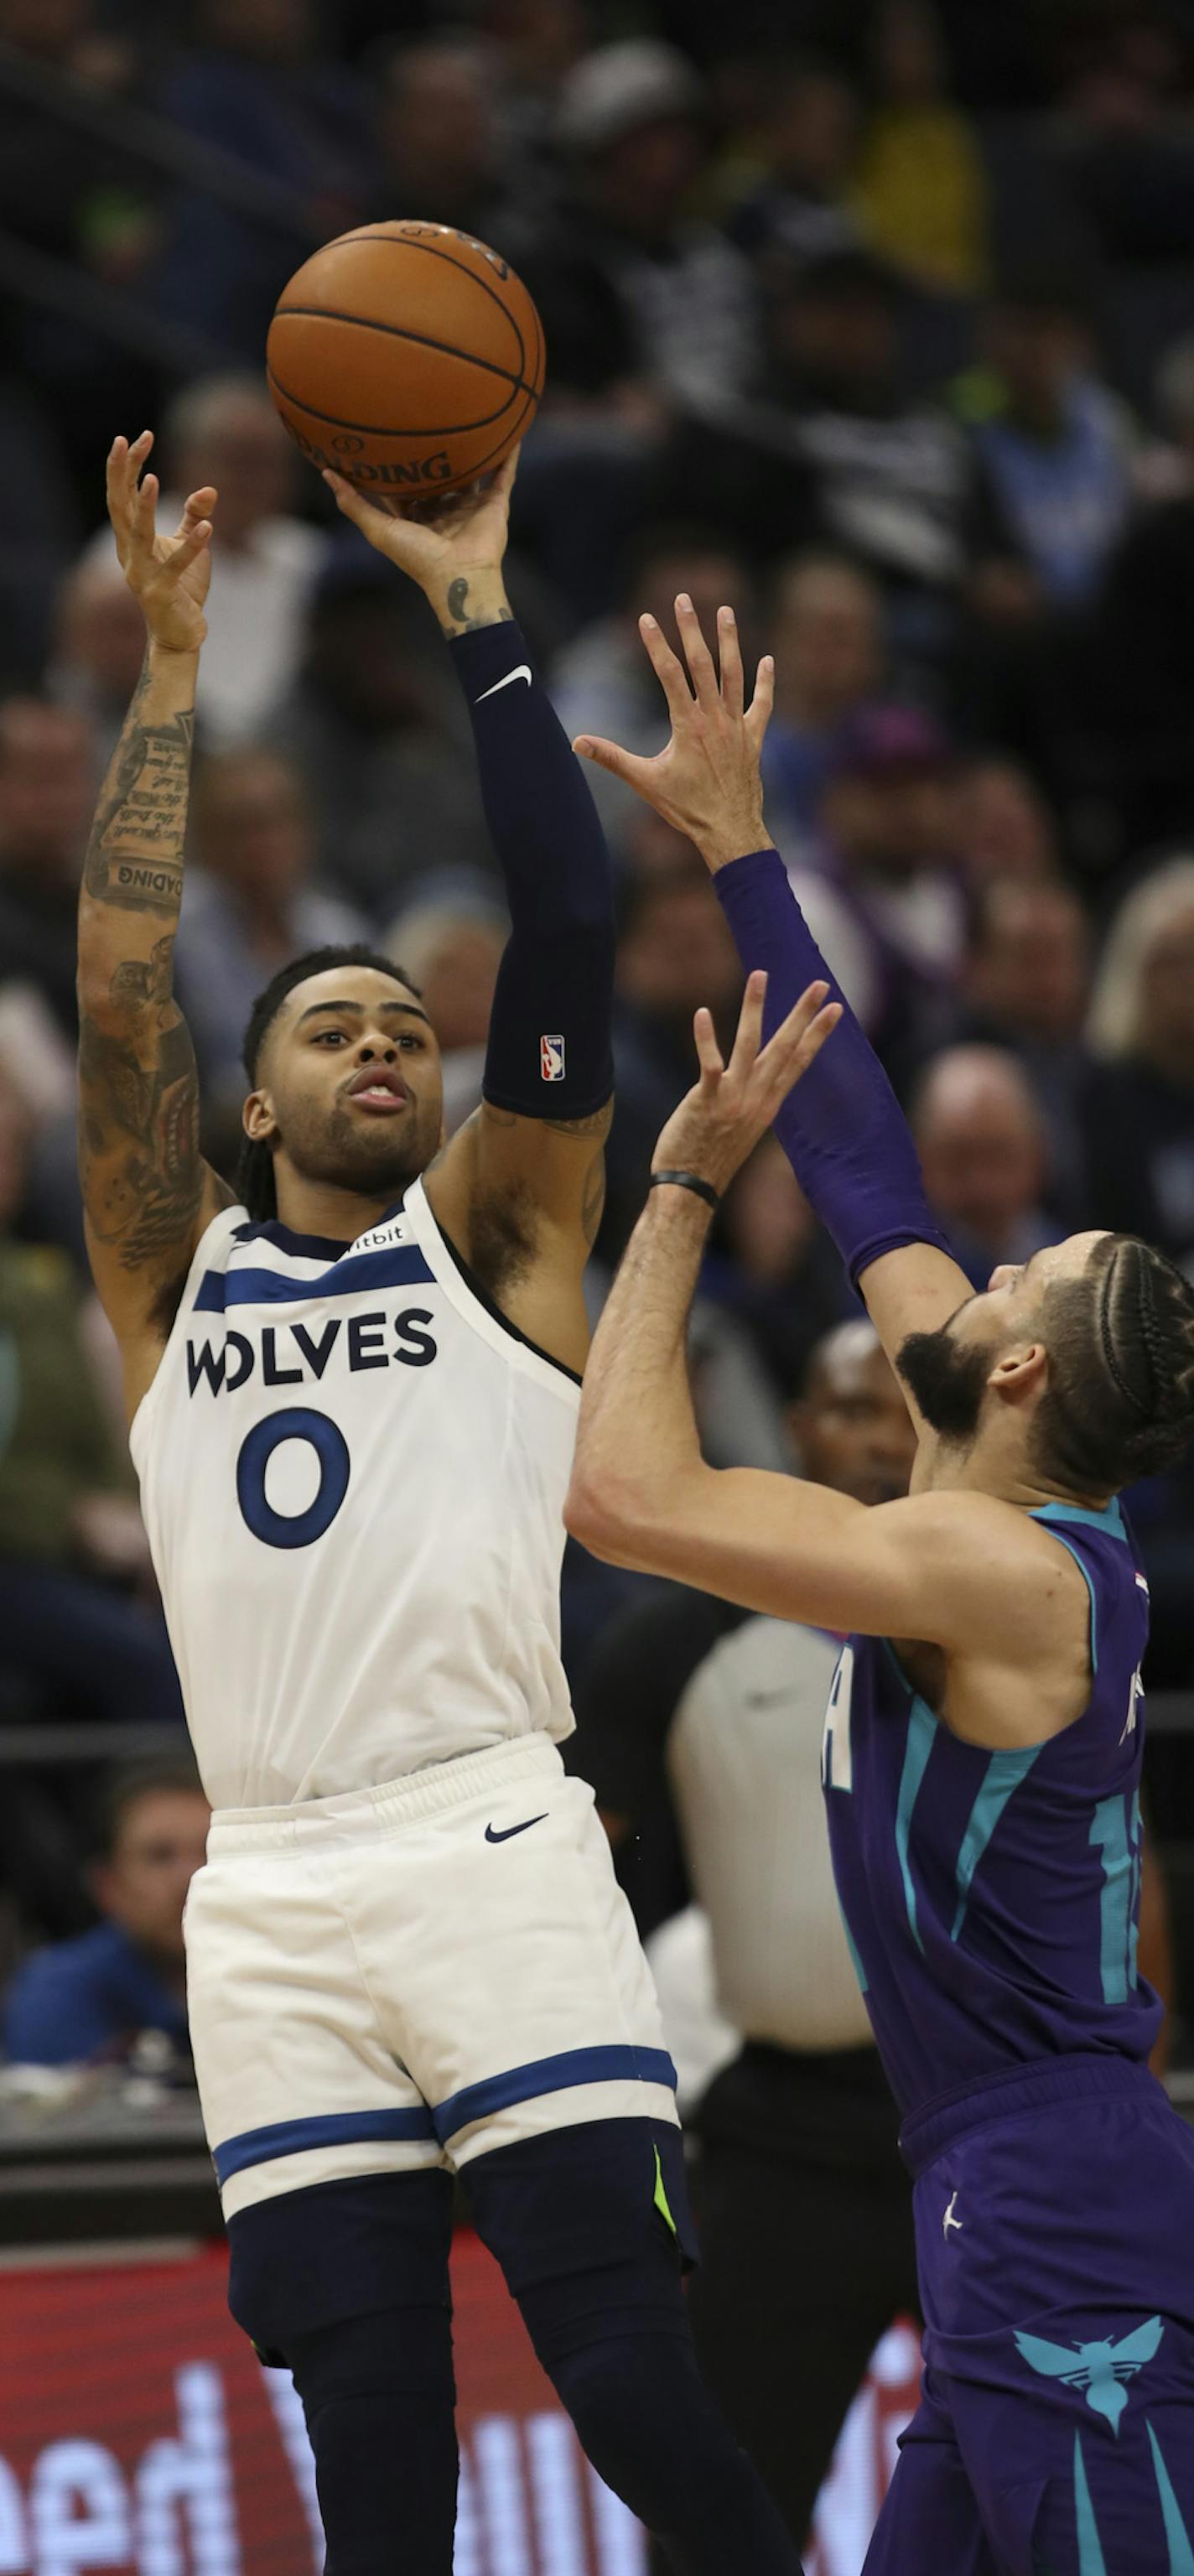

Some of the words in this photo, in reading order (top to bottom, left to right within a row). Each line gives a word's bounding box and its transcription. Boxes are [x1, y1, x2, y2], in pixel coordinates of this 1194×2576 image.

[118, 866, 183, 896] OADING
[347, 1226, 403, 1252] itbit
[187, 1308, 438, 1399] WOLVES
[236, 1407, 350, 1550] 0
